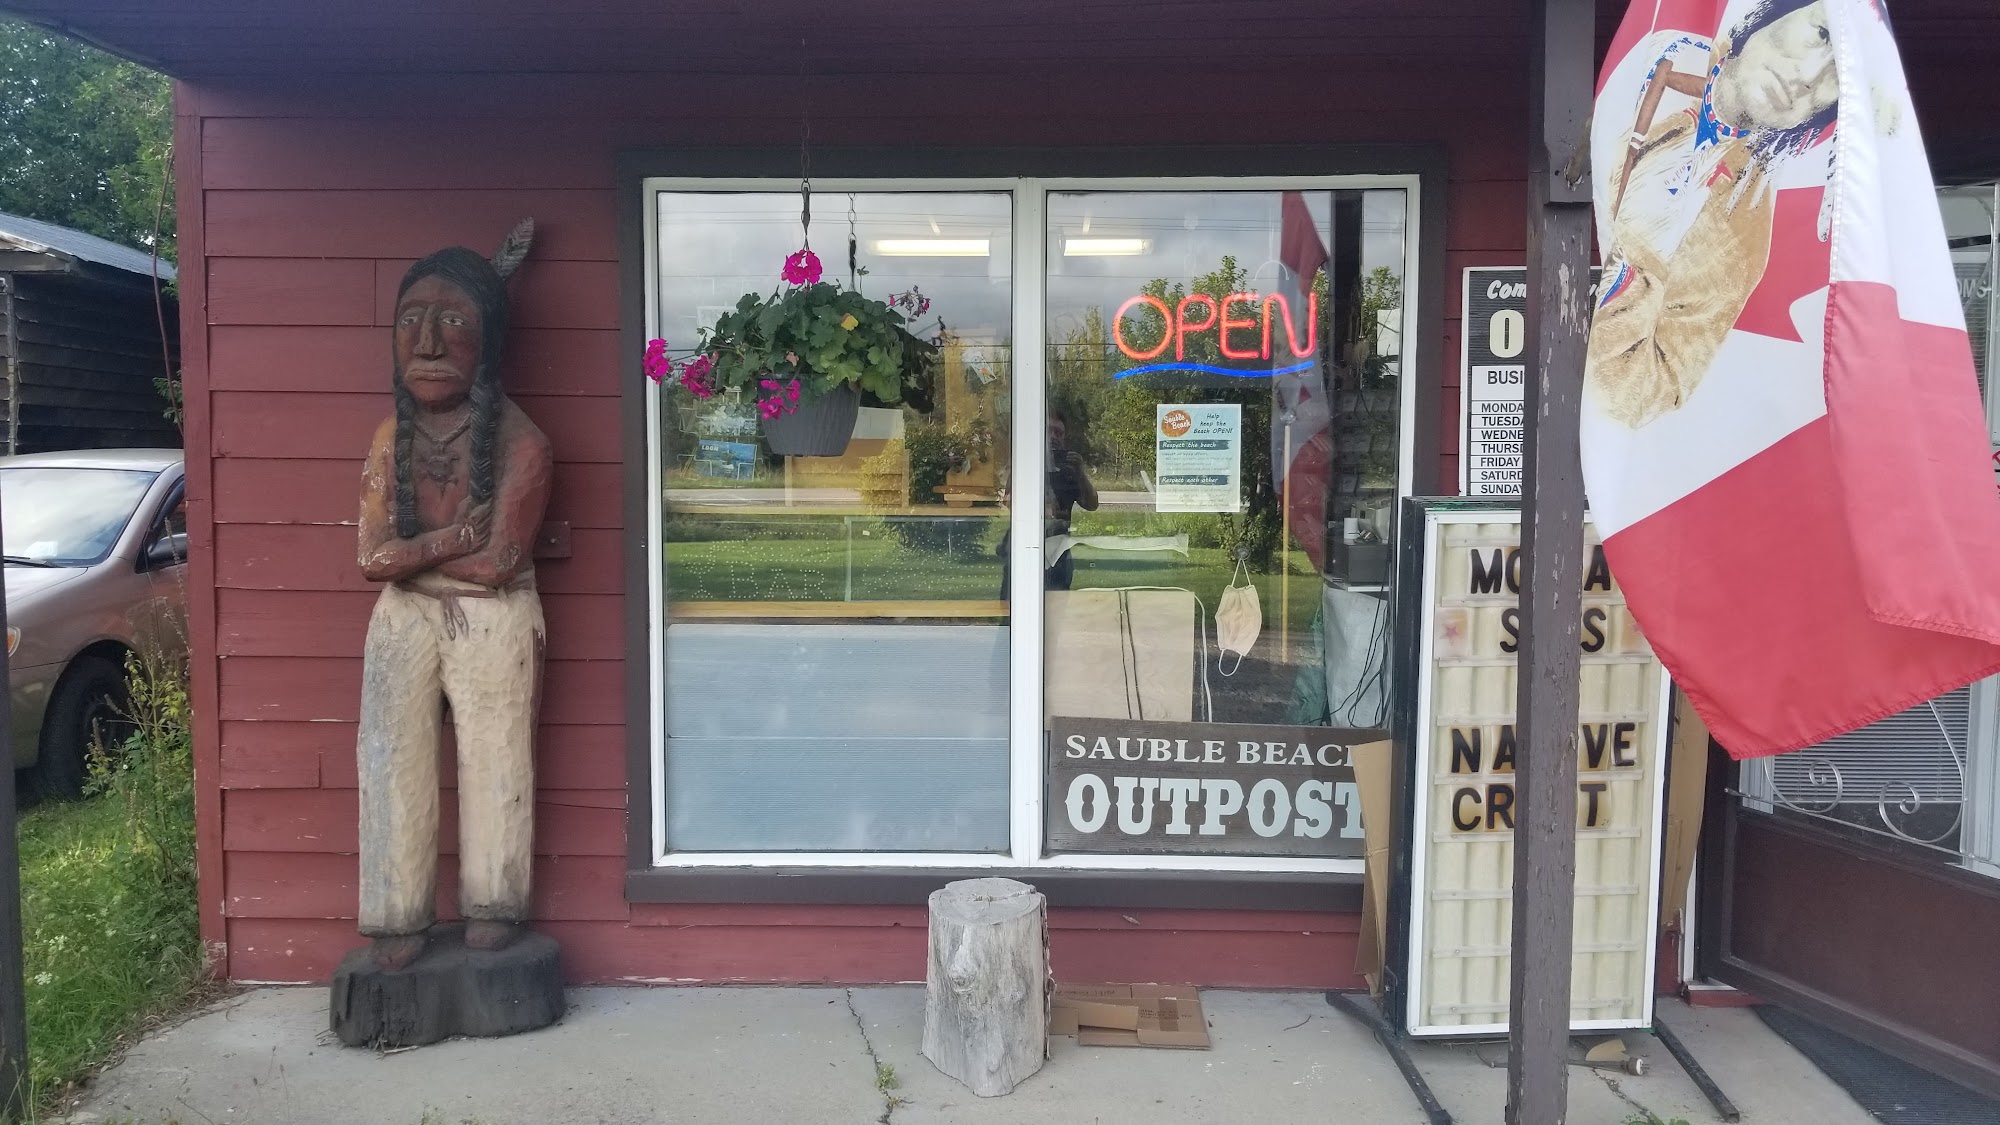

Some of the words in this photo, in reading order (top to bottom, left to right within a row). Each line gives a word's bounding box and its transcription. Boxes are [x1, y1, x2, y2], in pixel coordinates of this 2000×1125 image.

[1113, 293, 1318, 361] OPEN
[1488, 370, 1523, 385] BUSI
[1481, 403, 1523, 413] MONDA
[1481, 430, 1523, 440] WEDNE
[1480, 457, 1520, 467] FRIDAY
[1470, 547, 1611, 594] MOA
[1499, 608, 1606, 653] SS
[1065, 734, 1226, 764] SAUBLE
[1451, 723, 1636, 773] NAVE
[1064, 773, 1367, 839] OUTPOST
[1452, 783, 1606, 831] CRT
